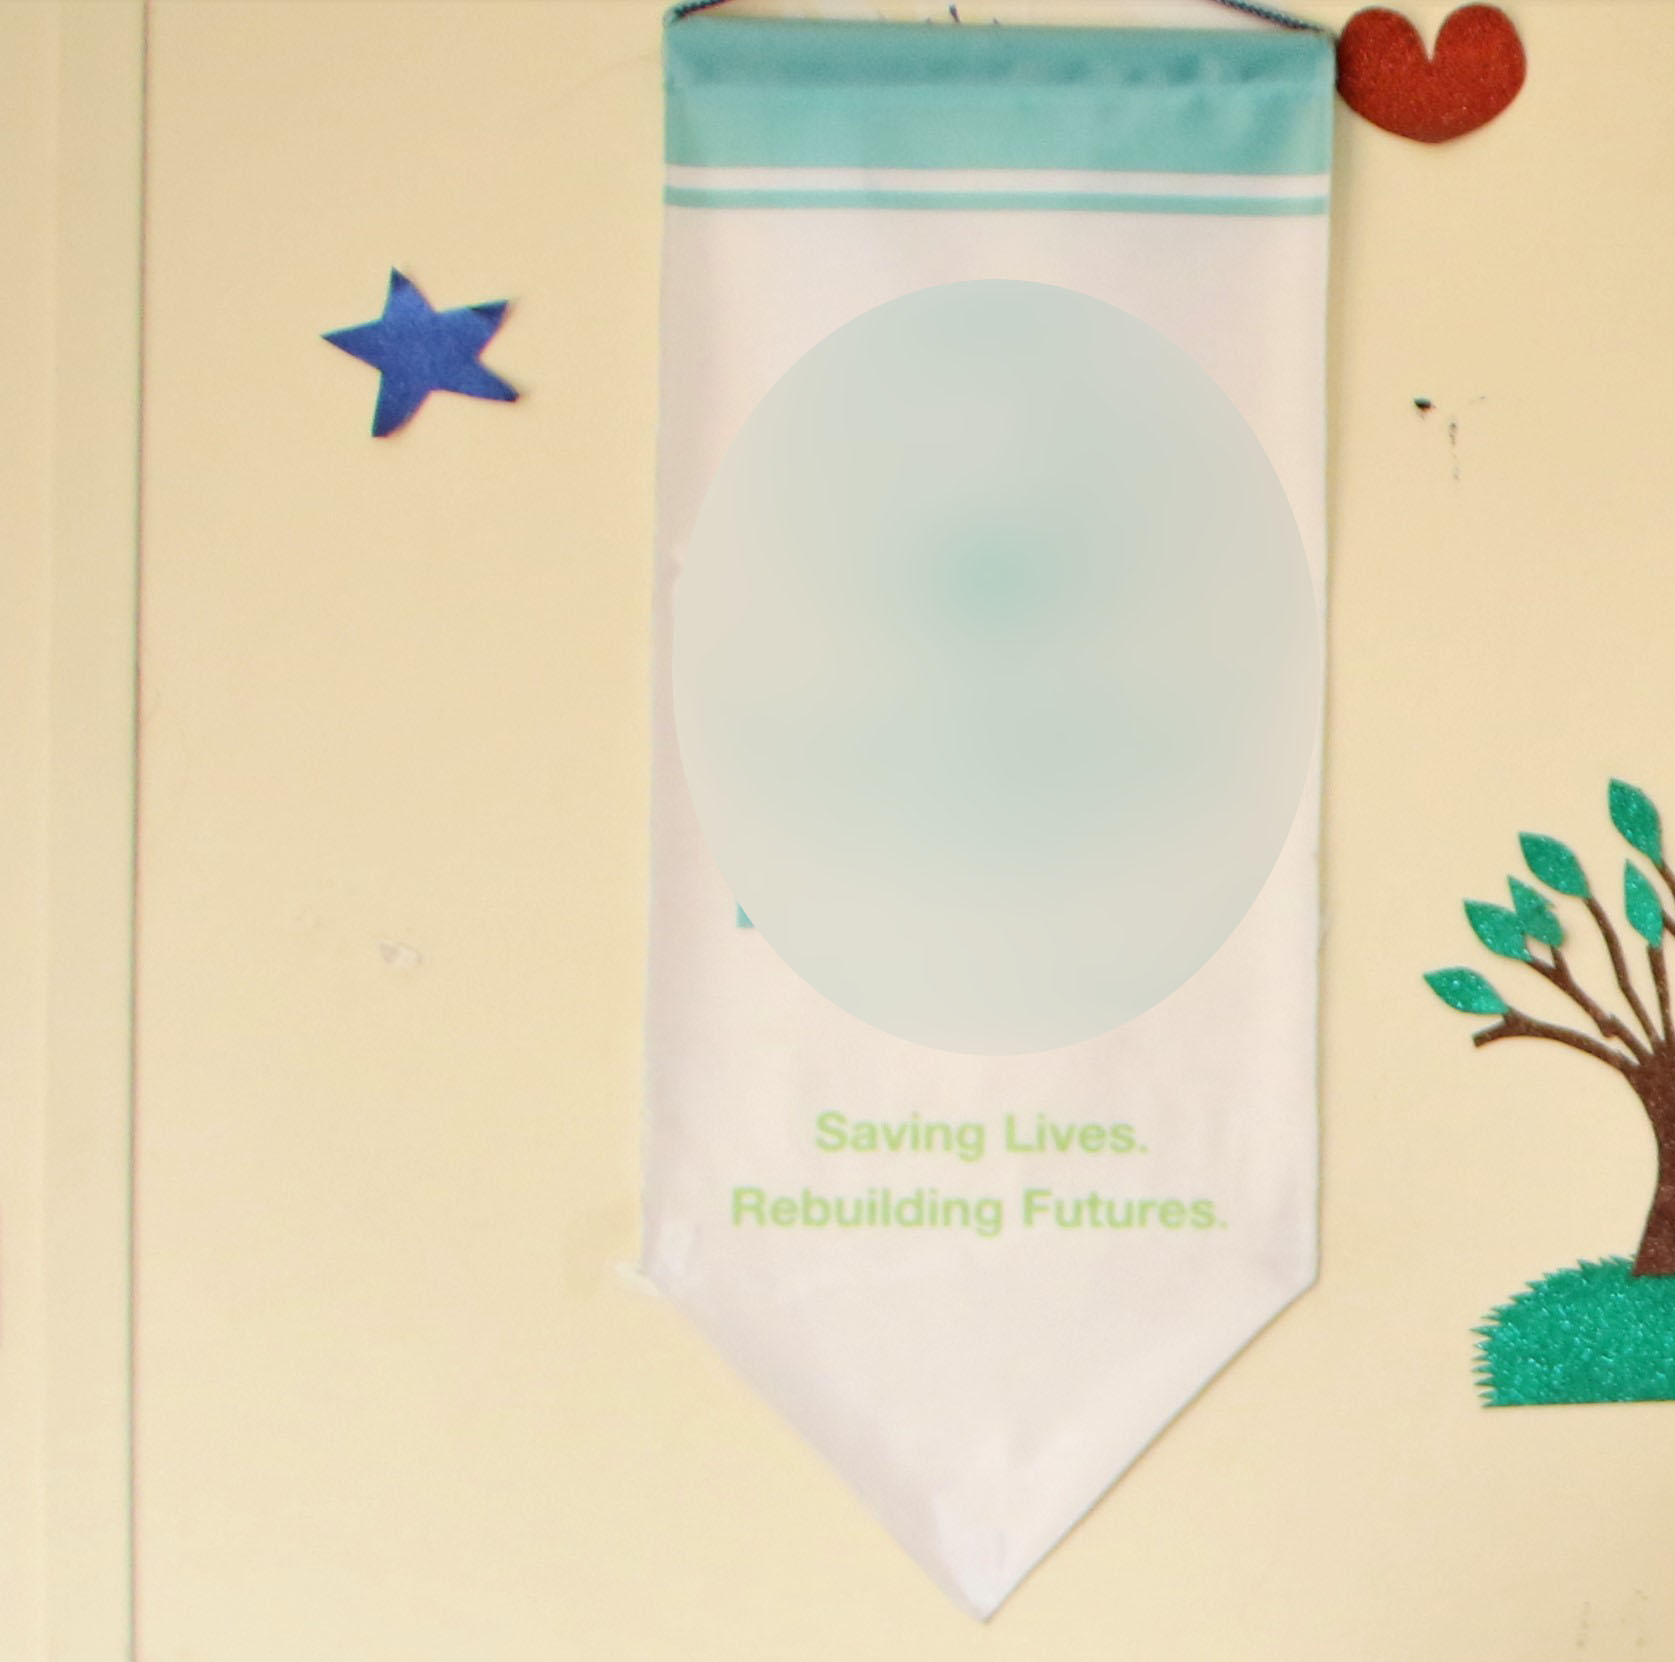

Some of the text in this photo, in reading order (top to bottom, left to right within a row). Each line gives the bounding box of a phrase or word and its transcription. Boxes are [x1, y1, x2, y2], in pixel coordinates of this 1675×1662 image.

[815, 1111, 1149, 1163] Saving Lives.
[731, 1187, 1229, 1238] Rebuilding Futures.
